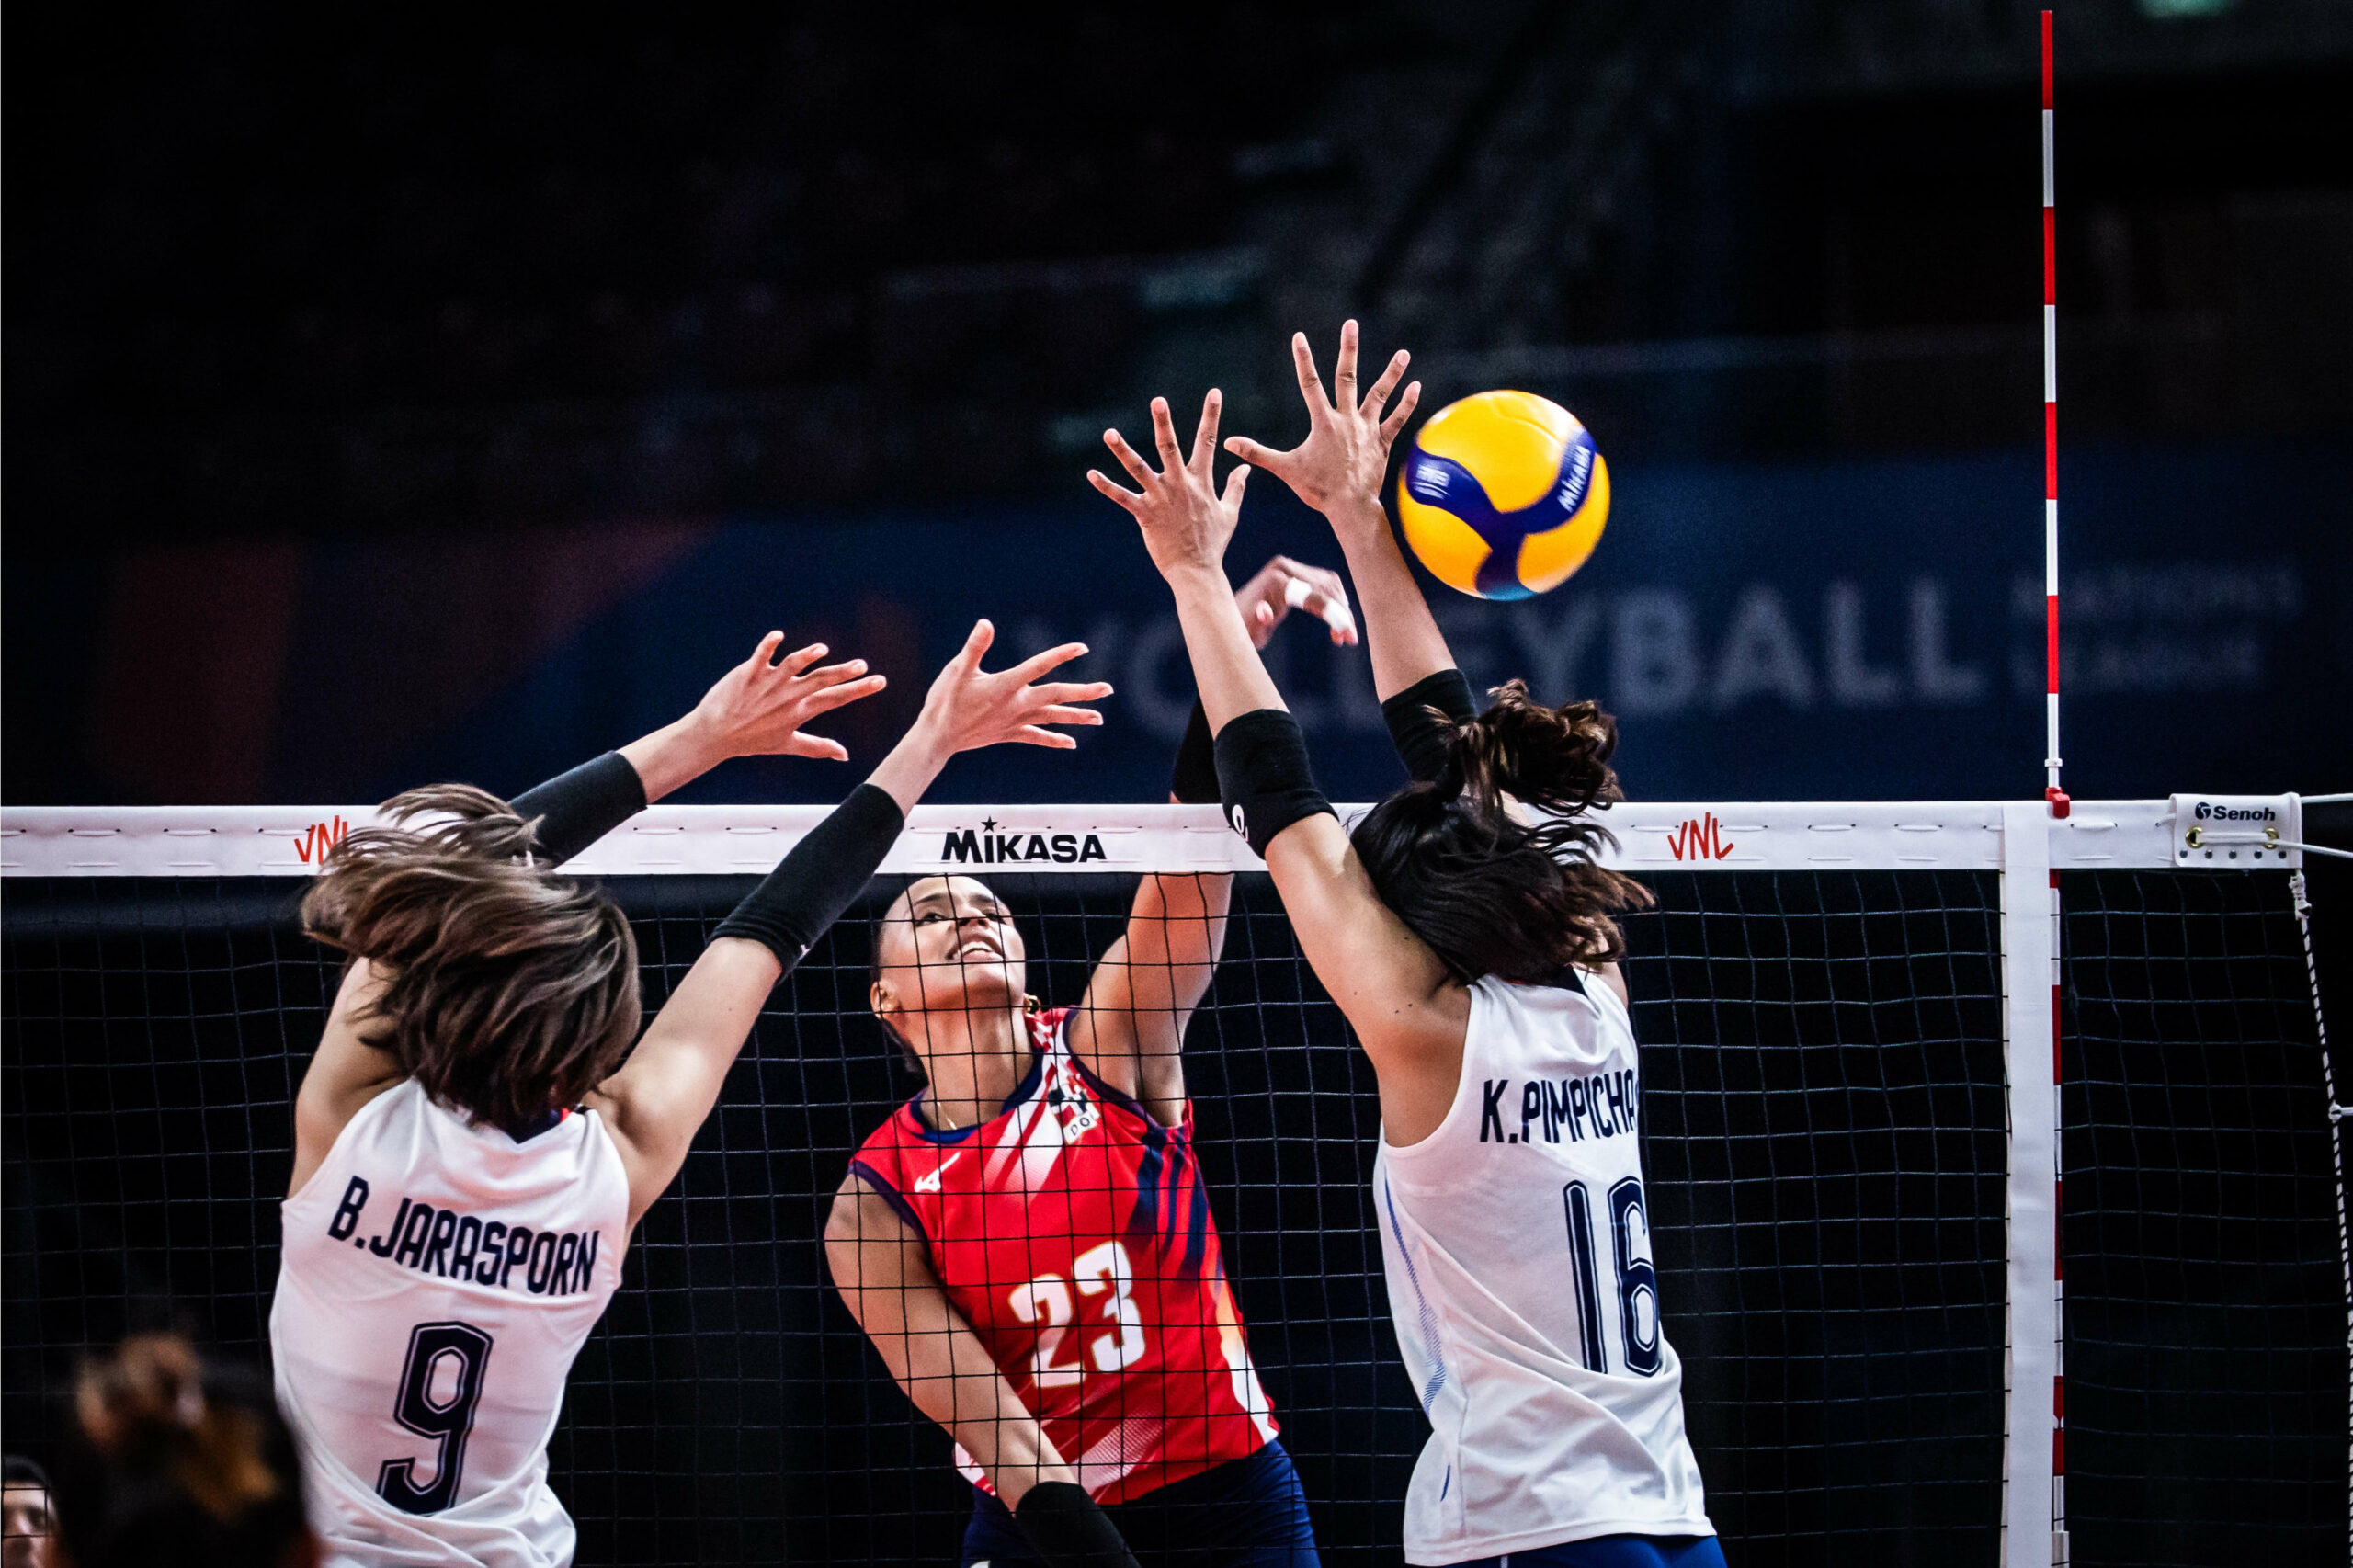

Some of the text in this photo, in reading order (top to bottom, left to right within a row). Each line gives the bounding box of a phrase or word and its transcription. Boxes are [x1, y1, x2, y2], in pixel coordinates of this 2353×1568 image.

[941, 817, 1107, 863] MIKASA
[1667, 812, 1734, 860] VNL
[2213, 805, 2276, 821] Senoh
[1480, 1070, 1639, 1144] K.PIMPICHA
[327, 1175, 600, 1295] B.JARASPORN
[1563, 1176, 1663, 1378] 16
[1008, 1240, 1146, 1388] 23
[376, 1320, 494, 1517] 9
